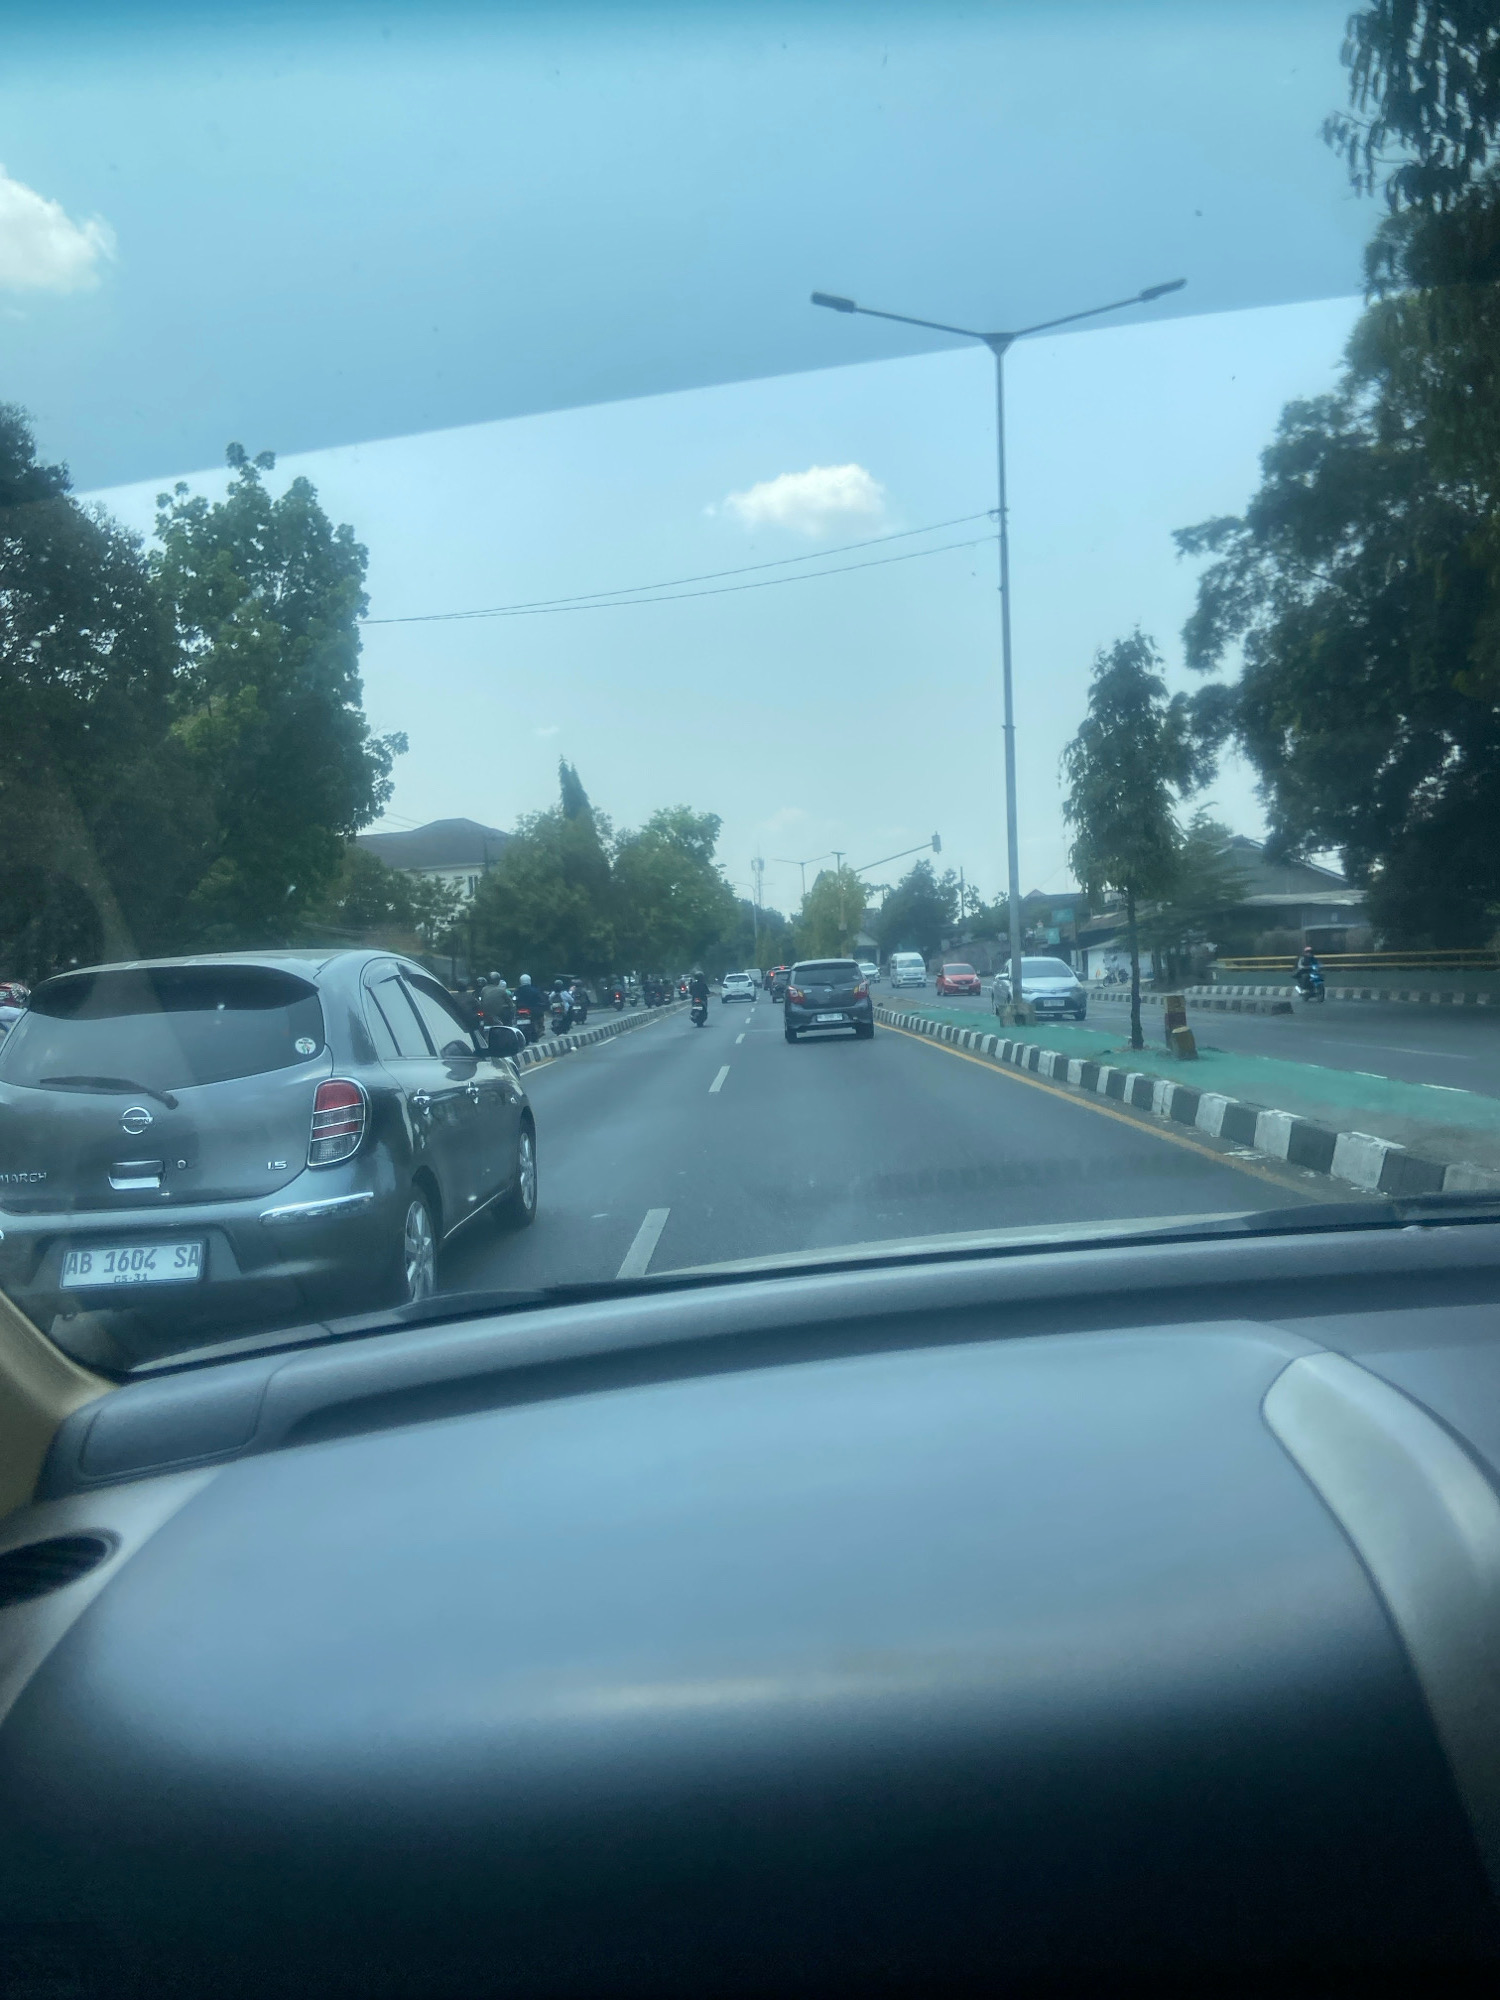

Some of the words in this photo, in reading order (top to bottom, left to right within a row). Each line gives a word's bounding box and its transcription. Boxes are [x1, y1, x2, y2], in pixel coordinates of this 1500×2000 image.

[66, 1253, 92, 1275] AB
[103, 1248, 158, 1273] 1604
[174, 1245, 199, 1268] SA
